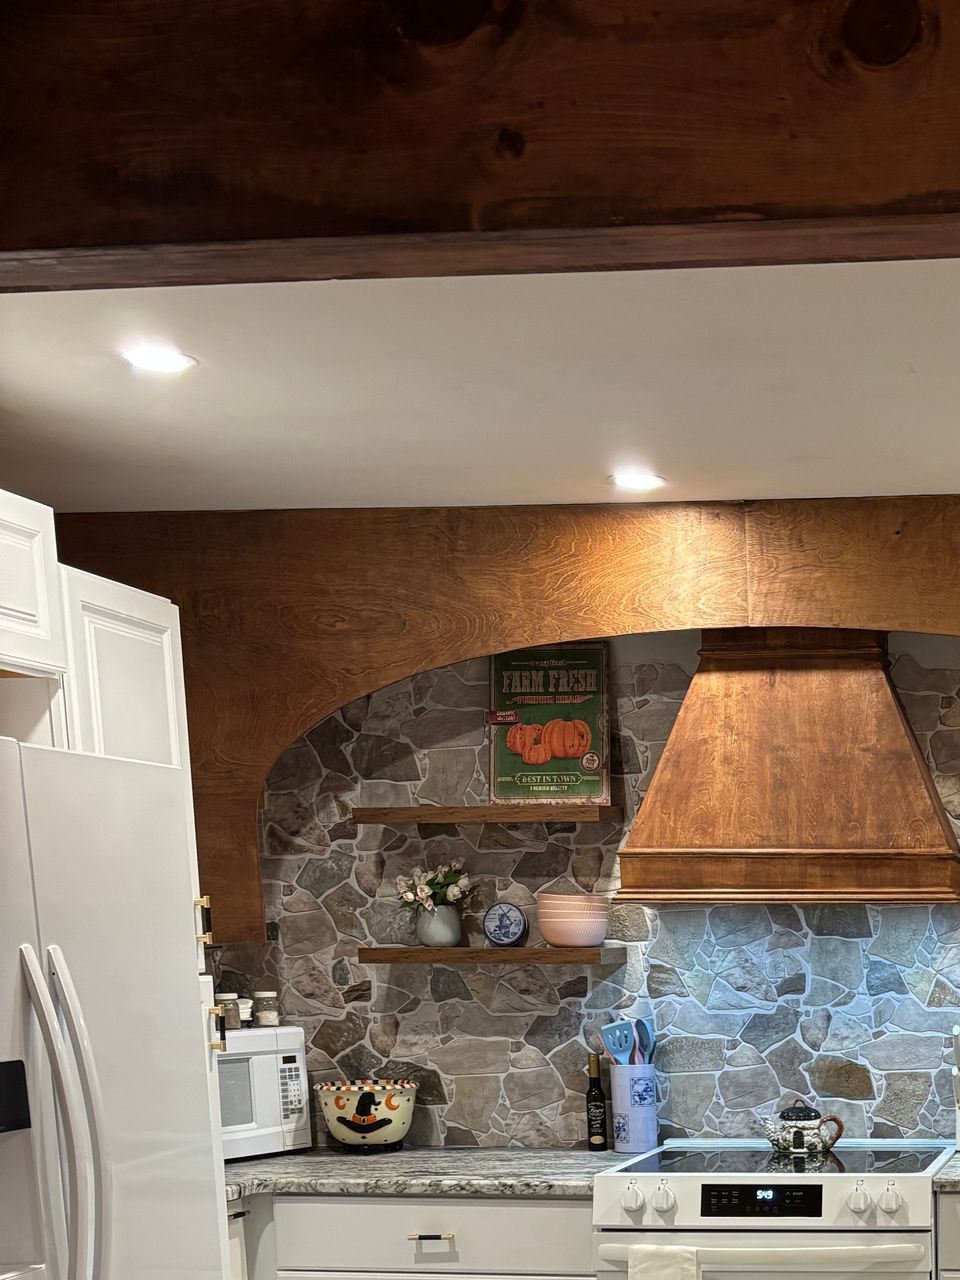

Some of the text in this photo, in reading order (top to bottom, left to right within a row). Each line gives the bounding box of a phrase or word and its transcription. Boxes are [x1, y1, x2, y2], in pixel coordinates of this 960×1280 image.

[502, 669, 597, 693] FARM FRESH
[522, 775, 577, 783] BEST IN TOWN
